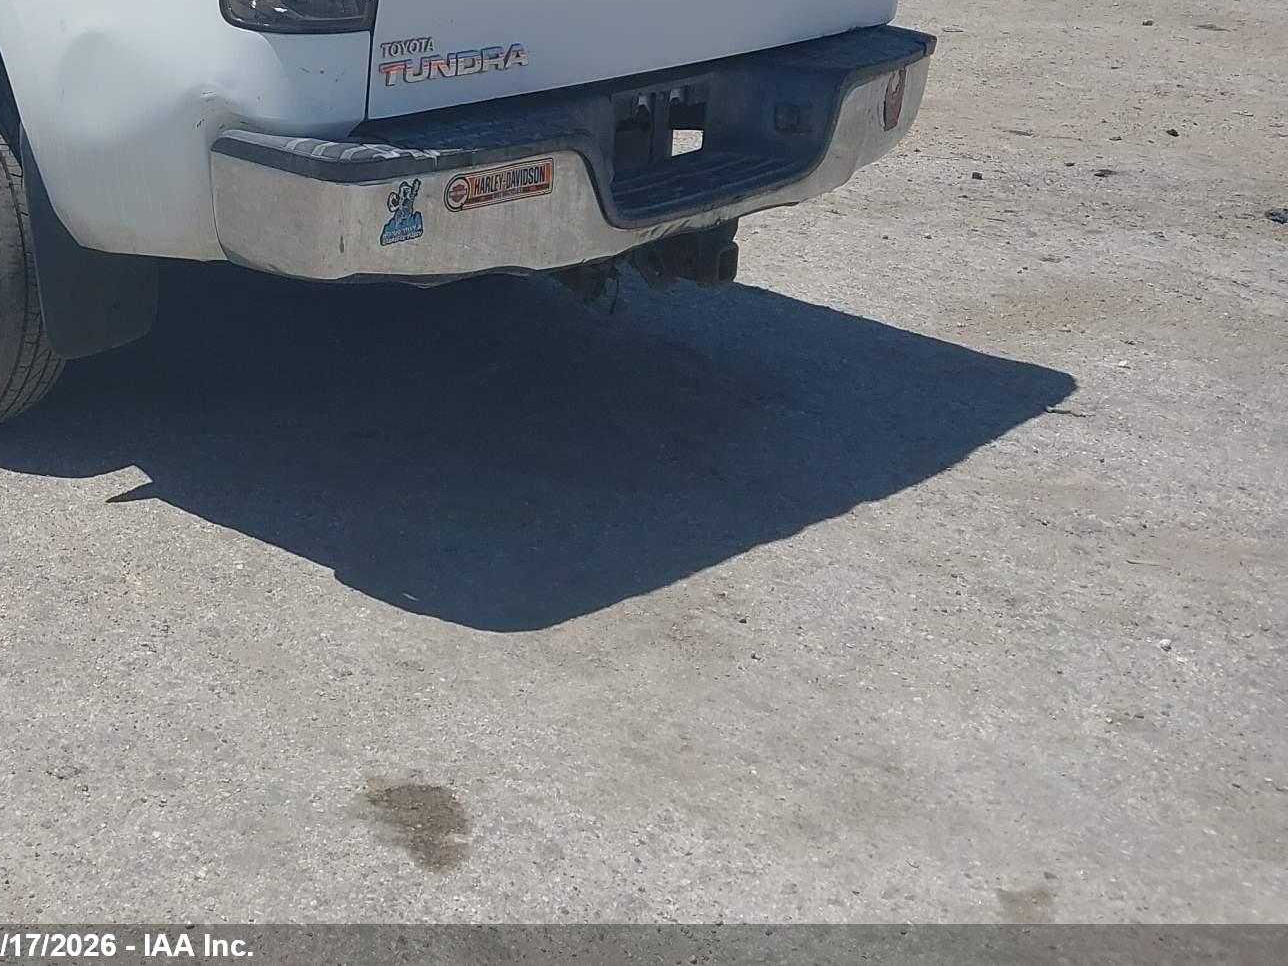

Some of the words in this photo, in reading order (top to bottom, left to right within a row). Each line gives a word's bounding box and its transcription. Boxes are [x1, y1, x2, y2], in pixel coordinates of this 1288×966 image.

[380, 36, 435, 58] TOYOTA
[378, 42, 530, 87] TUNDRA
[474, 165, 546, 195] HARLEY-DAVIDSON
